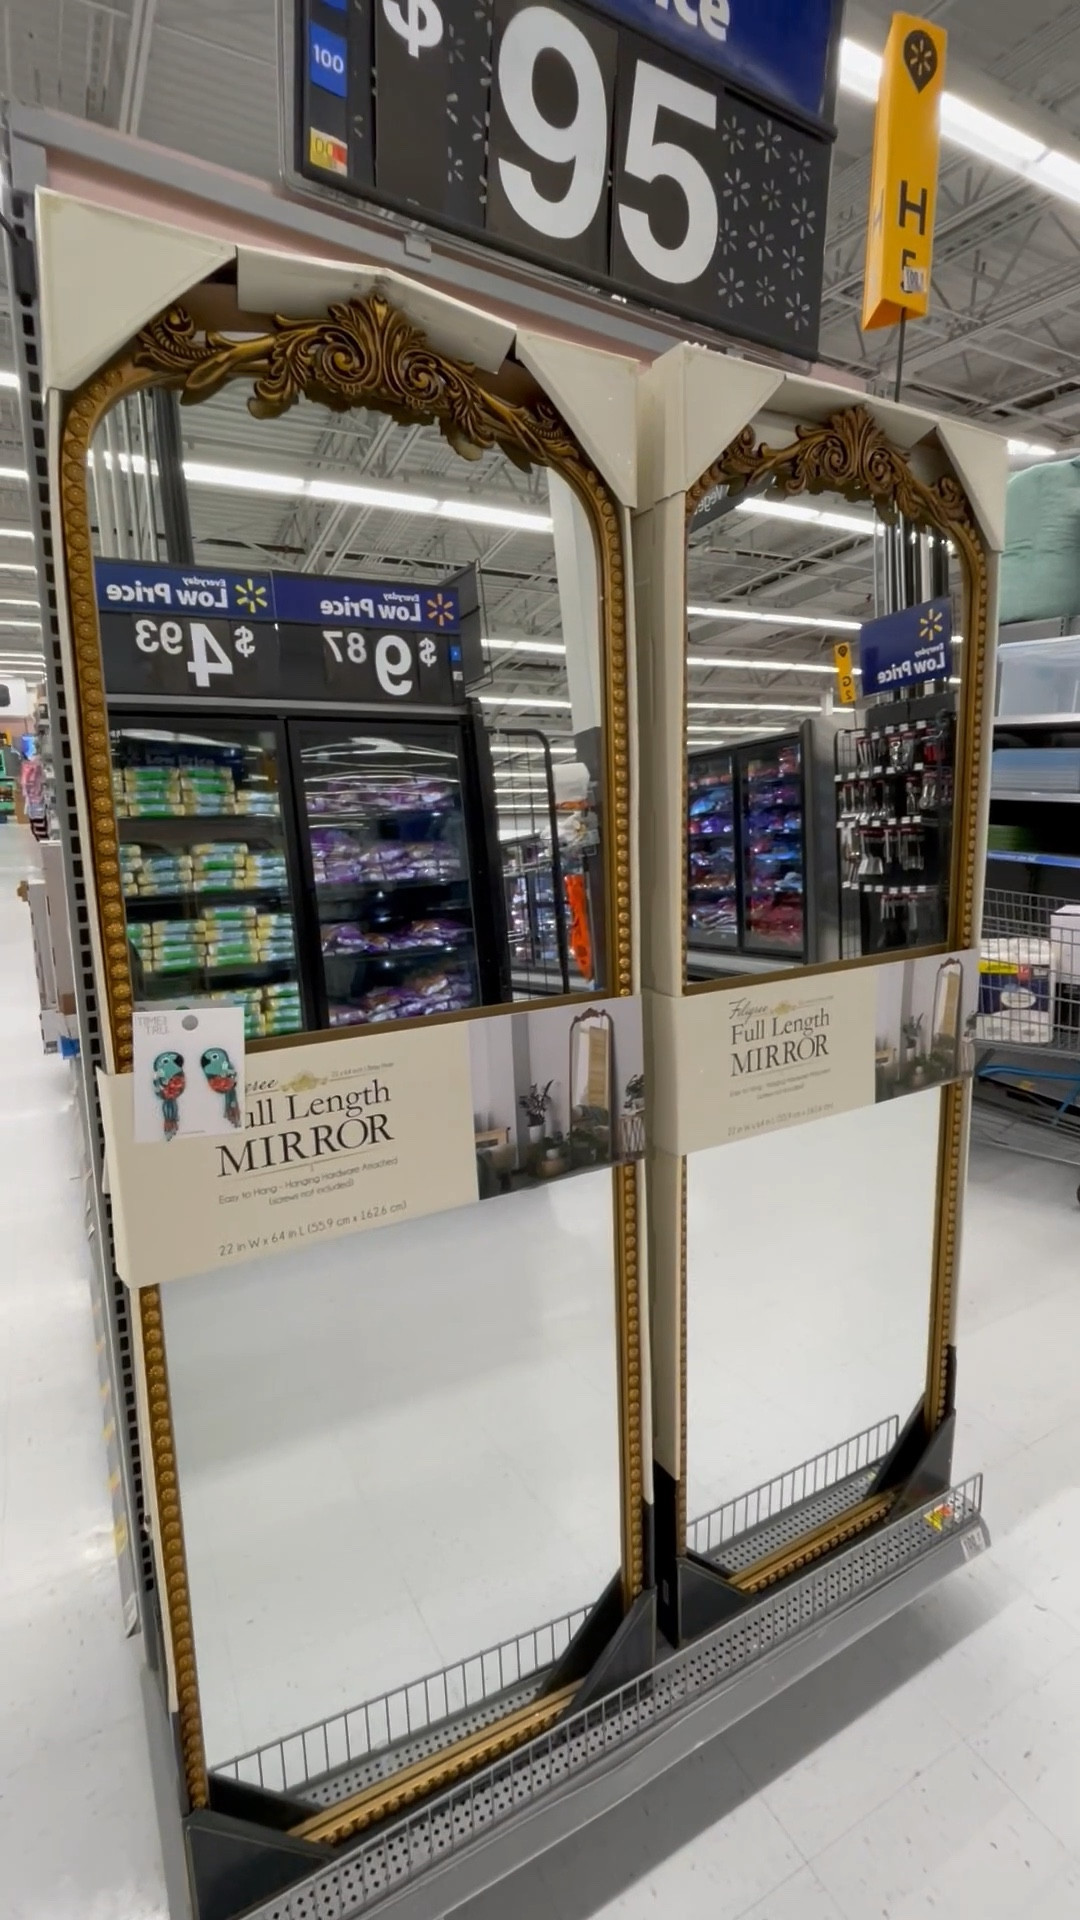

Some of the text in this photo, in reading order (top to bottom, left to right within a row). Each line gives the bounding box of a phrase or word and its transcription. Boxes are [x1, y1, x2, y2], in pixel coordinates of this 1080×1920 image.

[313, 44, 344, 74] 100
[899, 180, 927, 236] H
[731, 1008, 830, 1045] Full Length
[730, 1034, 829, 1077] MIRROR
[285, 1079, 392, 1120] Length
[215, 1113, 395, 1177] MIRROR
[218, 1194, 239, 1205] Easy
[253, 1185, 278, 1197] Hang
[285, 1176, 320, 1189] Hanging
[321, 1166, 360, 1180] Hardware
[300, 1189, 315, 1198] not
[219, 1243, 233, 1256] 22
[237, 1241, 247, 1251] in
[248, 1238, 261, 1248] W
[271, 1231, 285, 1244] 64
[288, 1227, 297, 1238] in
[299, 1226, 304, 1236] L
[336, 1216, 350, 1226] cm
